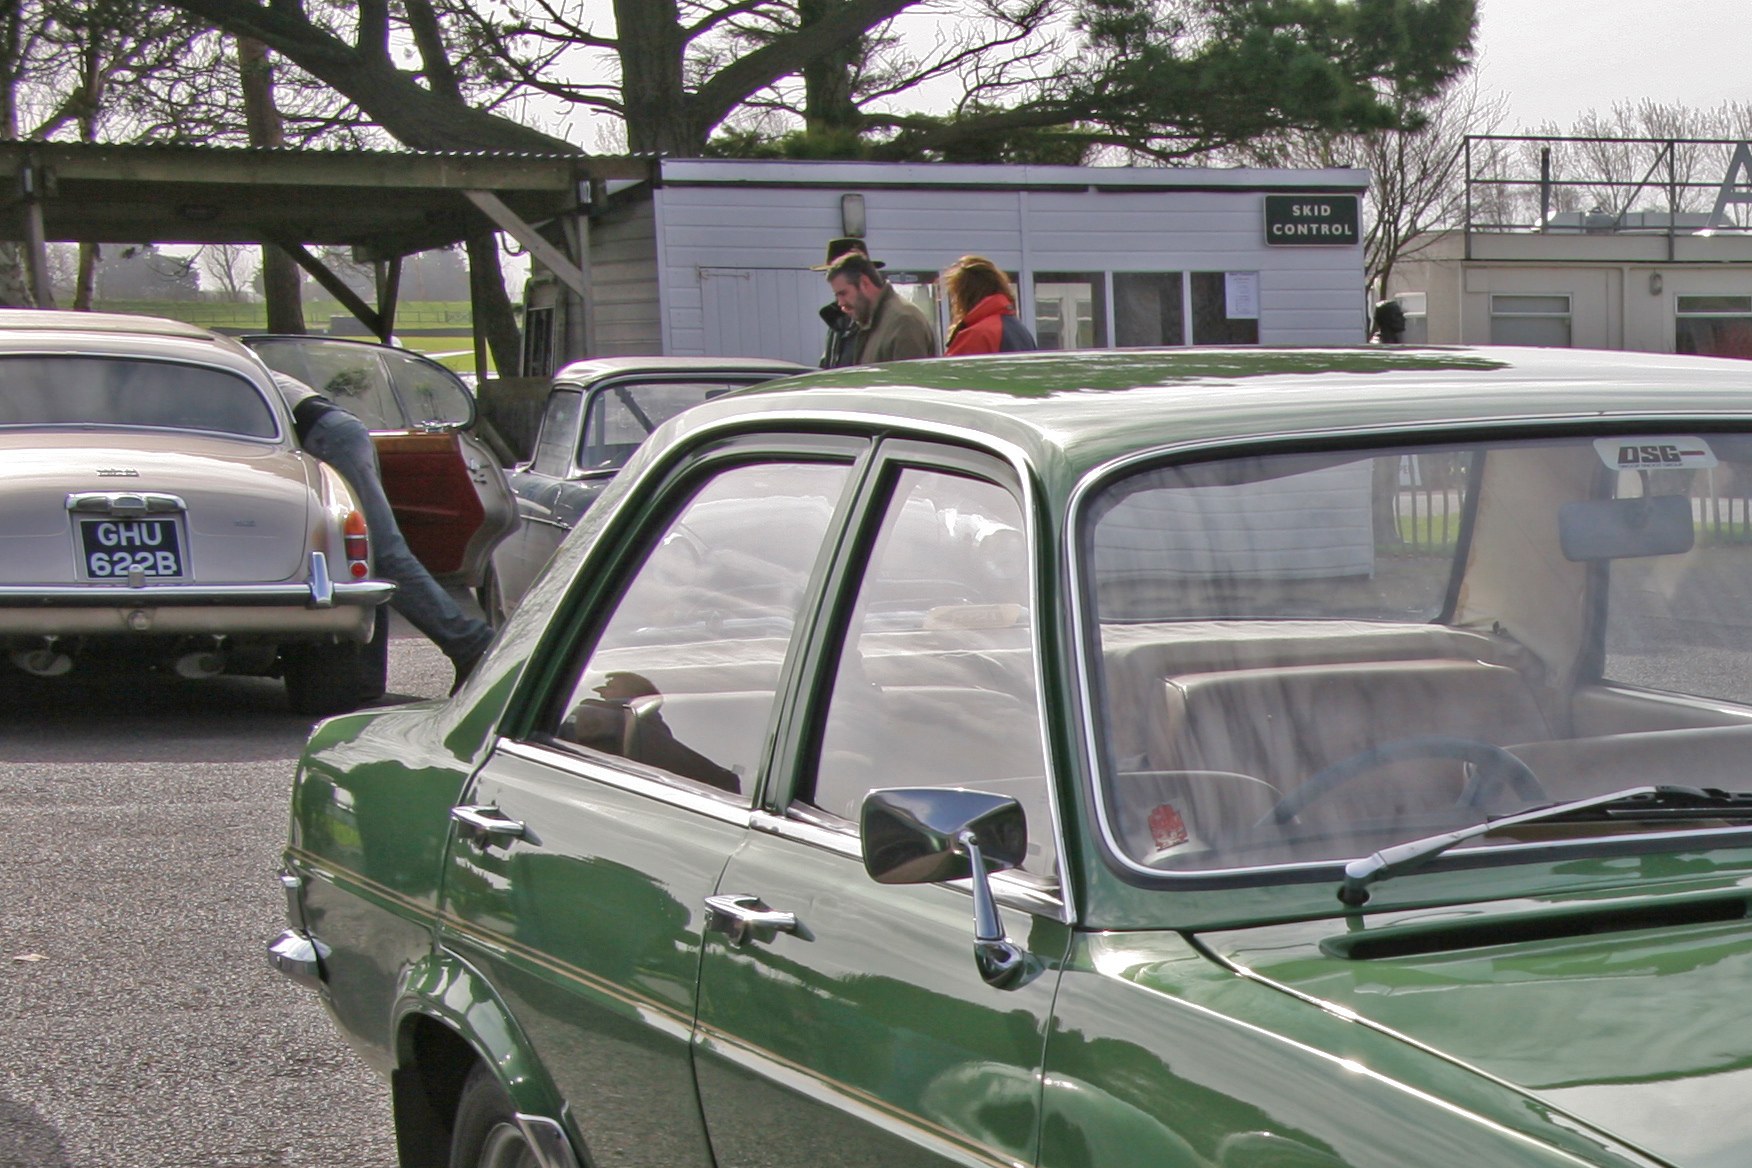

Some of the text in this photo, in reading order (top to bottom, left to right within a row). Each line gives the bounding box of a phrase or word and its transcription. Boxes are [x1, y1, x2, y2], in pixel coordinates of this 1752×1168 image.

[1292, 205, 1331, 216] SKID
[1273, 224, 1352, 235] CONTROL
[1618, 445, 1681, 464] DSG
[97, 522, 163, 546] GHU
[90, 551, 177, 575] 622B
